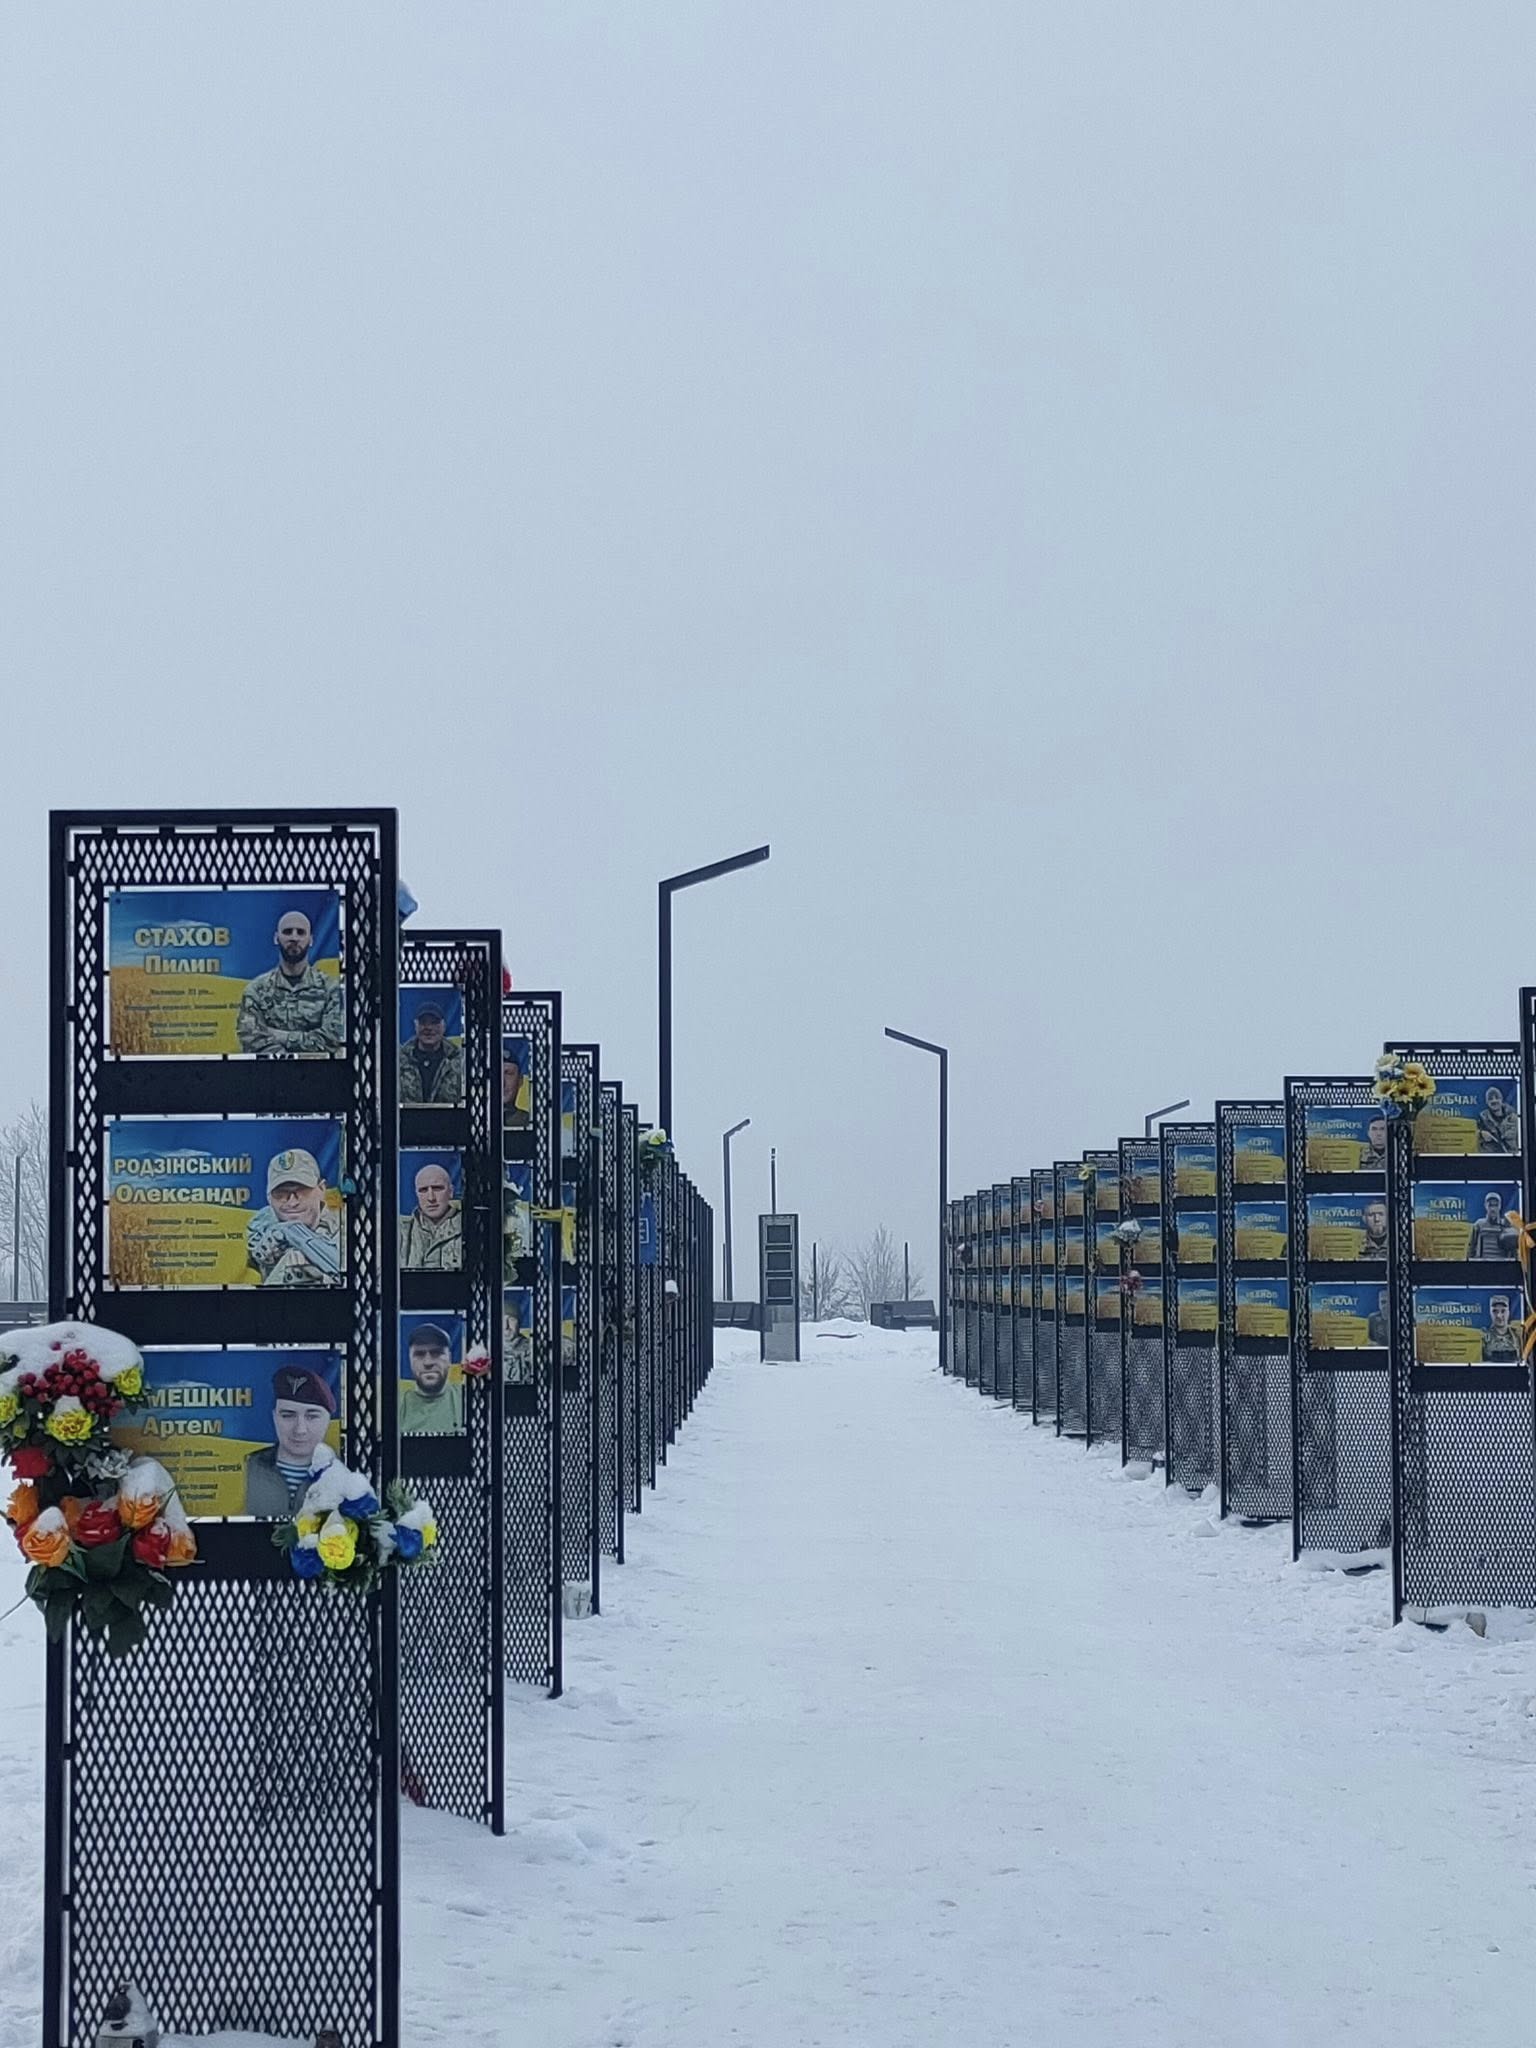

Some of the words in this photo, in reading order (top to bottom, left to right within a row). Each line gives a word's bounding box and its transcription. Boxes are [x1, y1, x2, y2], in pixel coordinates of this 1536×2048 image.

[134, 926, 231, 948] СТАХОВ
[144, 955, 220, 974] Пилип
[113, 1153, 253, 1177] РОДЗІНСЬКИЙ
[114, 1184, 250, 1205] Олександр
[1417, 1303, 1482, 1314] САВИЦЬКИЙ
[143, 1416, 224, 1438] Артем
